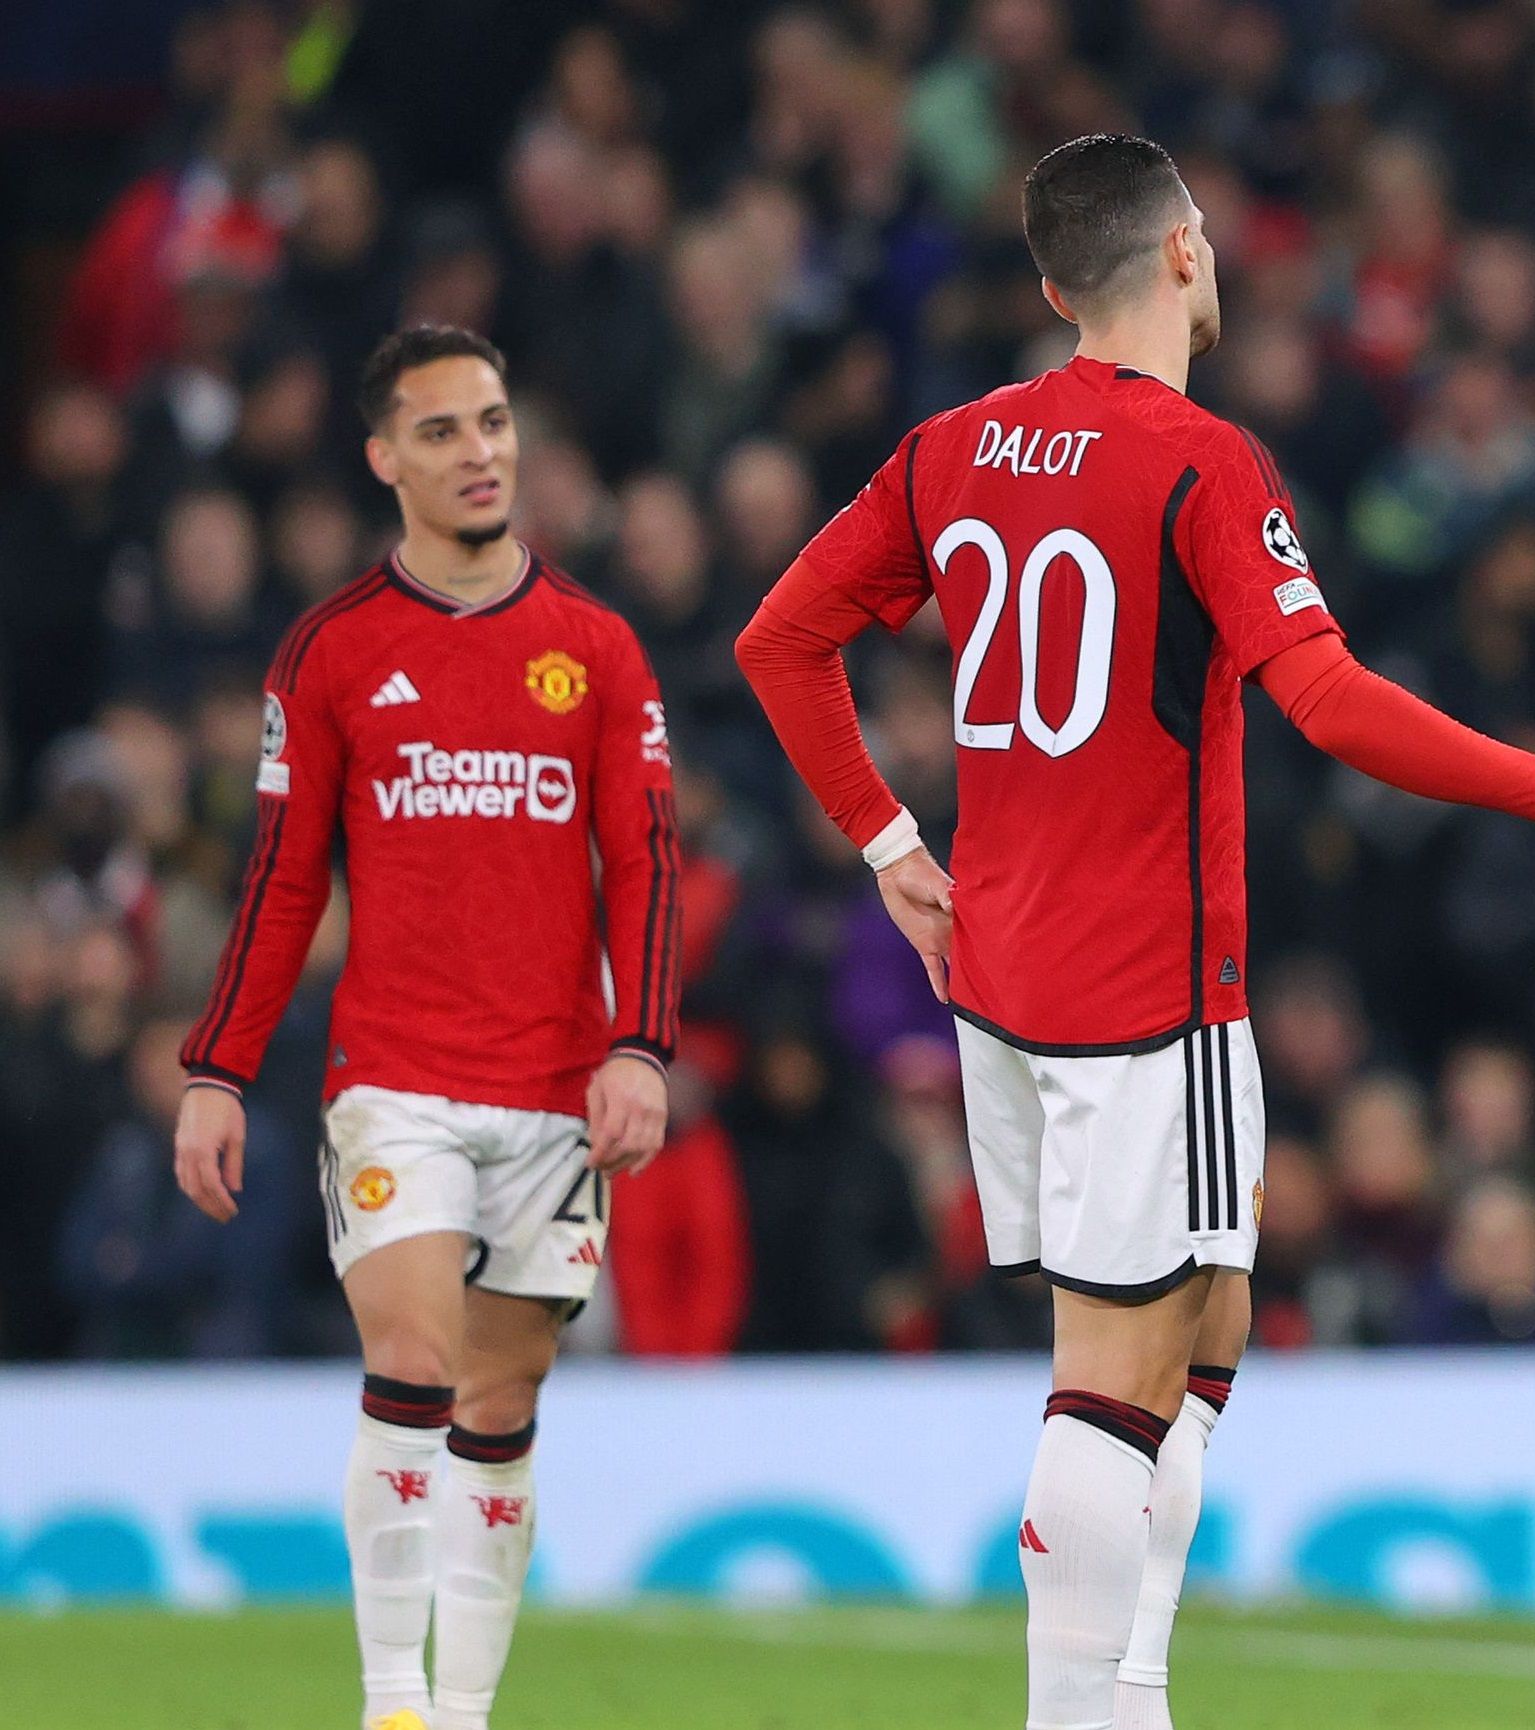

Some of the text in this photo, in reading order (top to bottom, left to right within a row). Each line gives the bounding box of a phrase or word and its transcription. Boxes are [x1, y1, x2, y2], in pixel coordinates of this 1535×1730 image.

[973, 420, 1103, 477] DALOT
[931, 517, 1118, 759] 20
[396, 740, 527, 784] Team
[371, 775, 527, 822] Viewer
